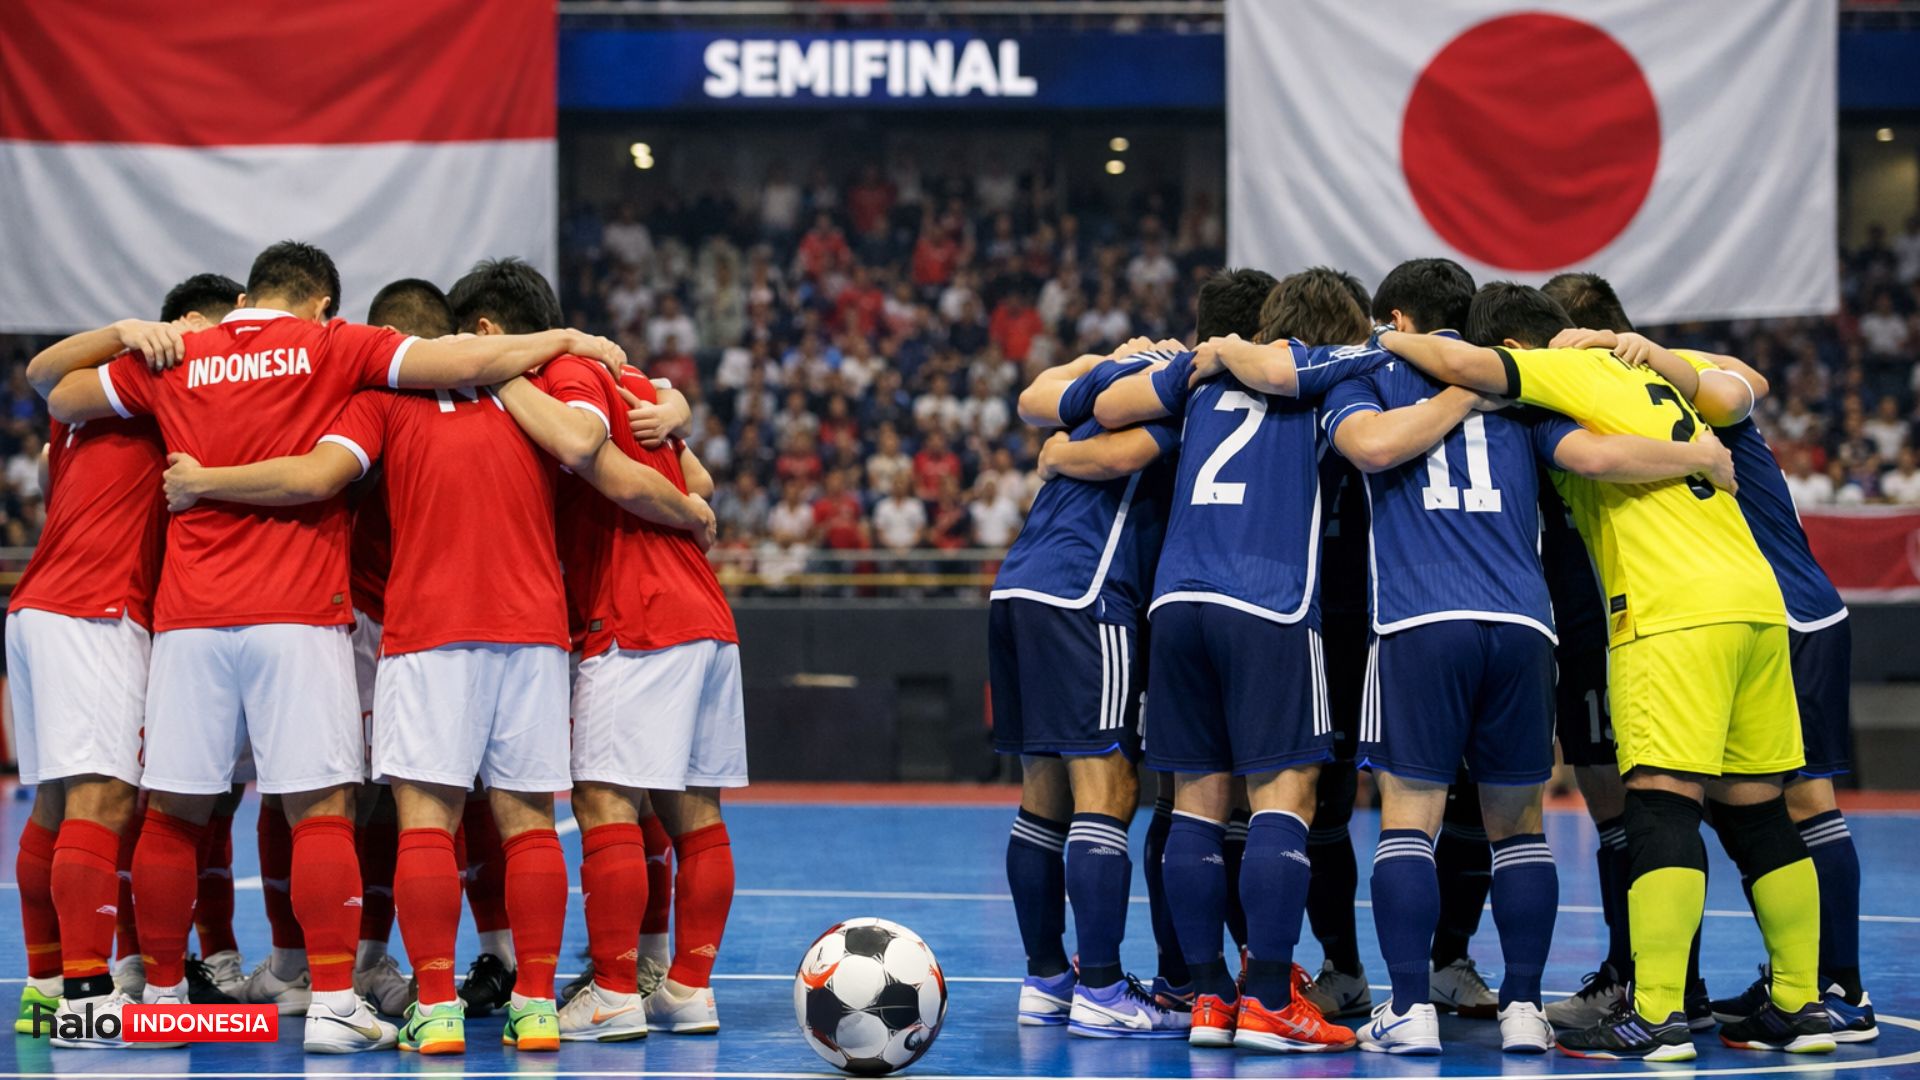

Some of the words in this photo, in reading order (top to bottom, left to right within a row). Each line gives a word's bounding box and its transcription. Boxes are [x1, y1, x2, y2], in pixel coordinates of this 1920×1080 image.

[703, 39, 1038, 98] SEMIFINAL
[187, 347, 312, 389] INDONESIA
[1190, 390, 1268, 505] 2
[1415, 397, 1502, 513] 11
